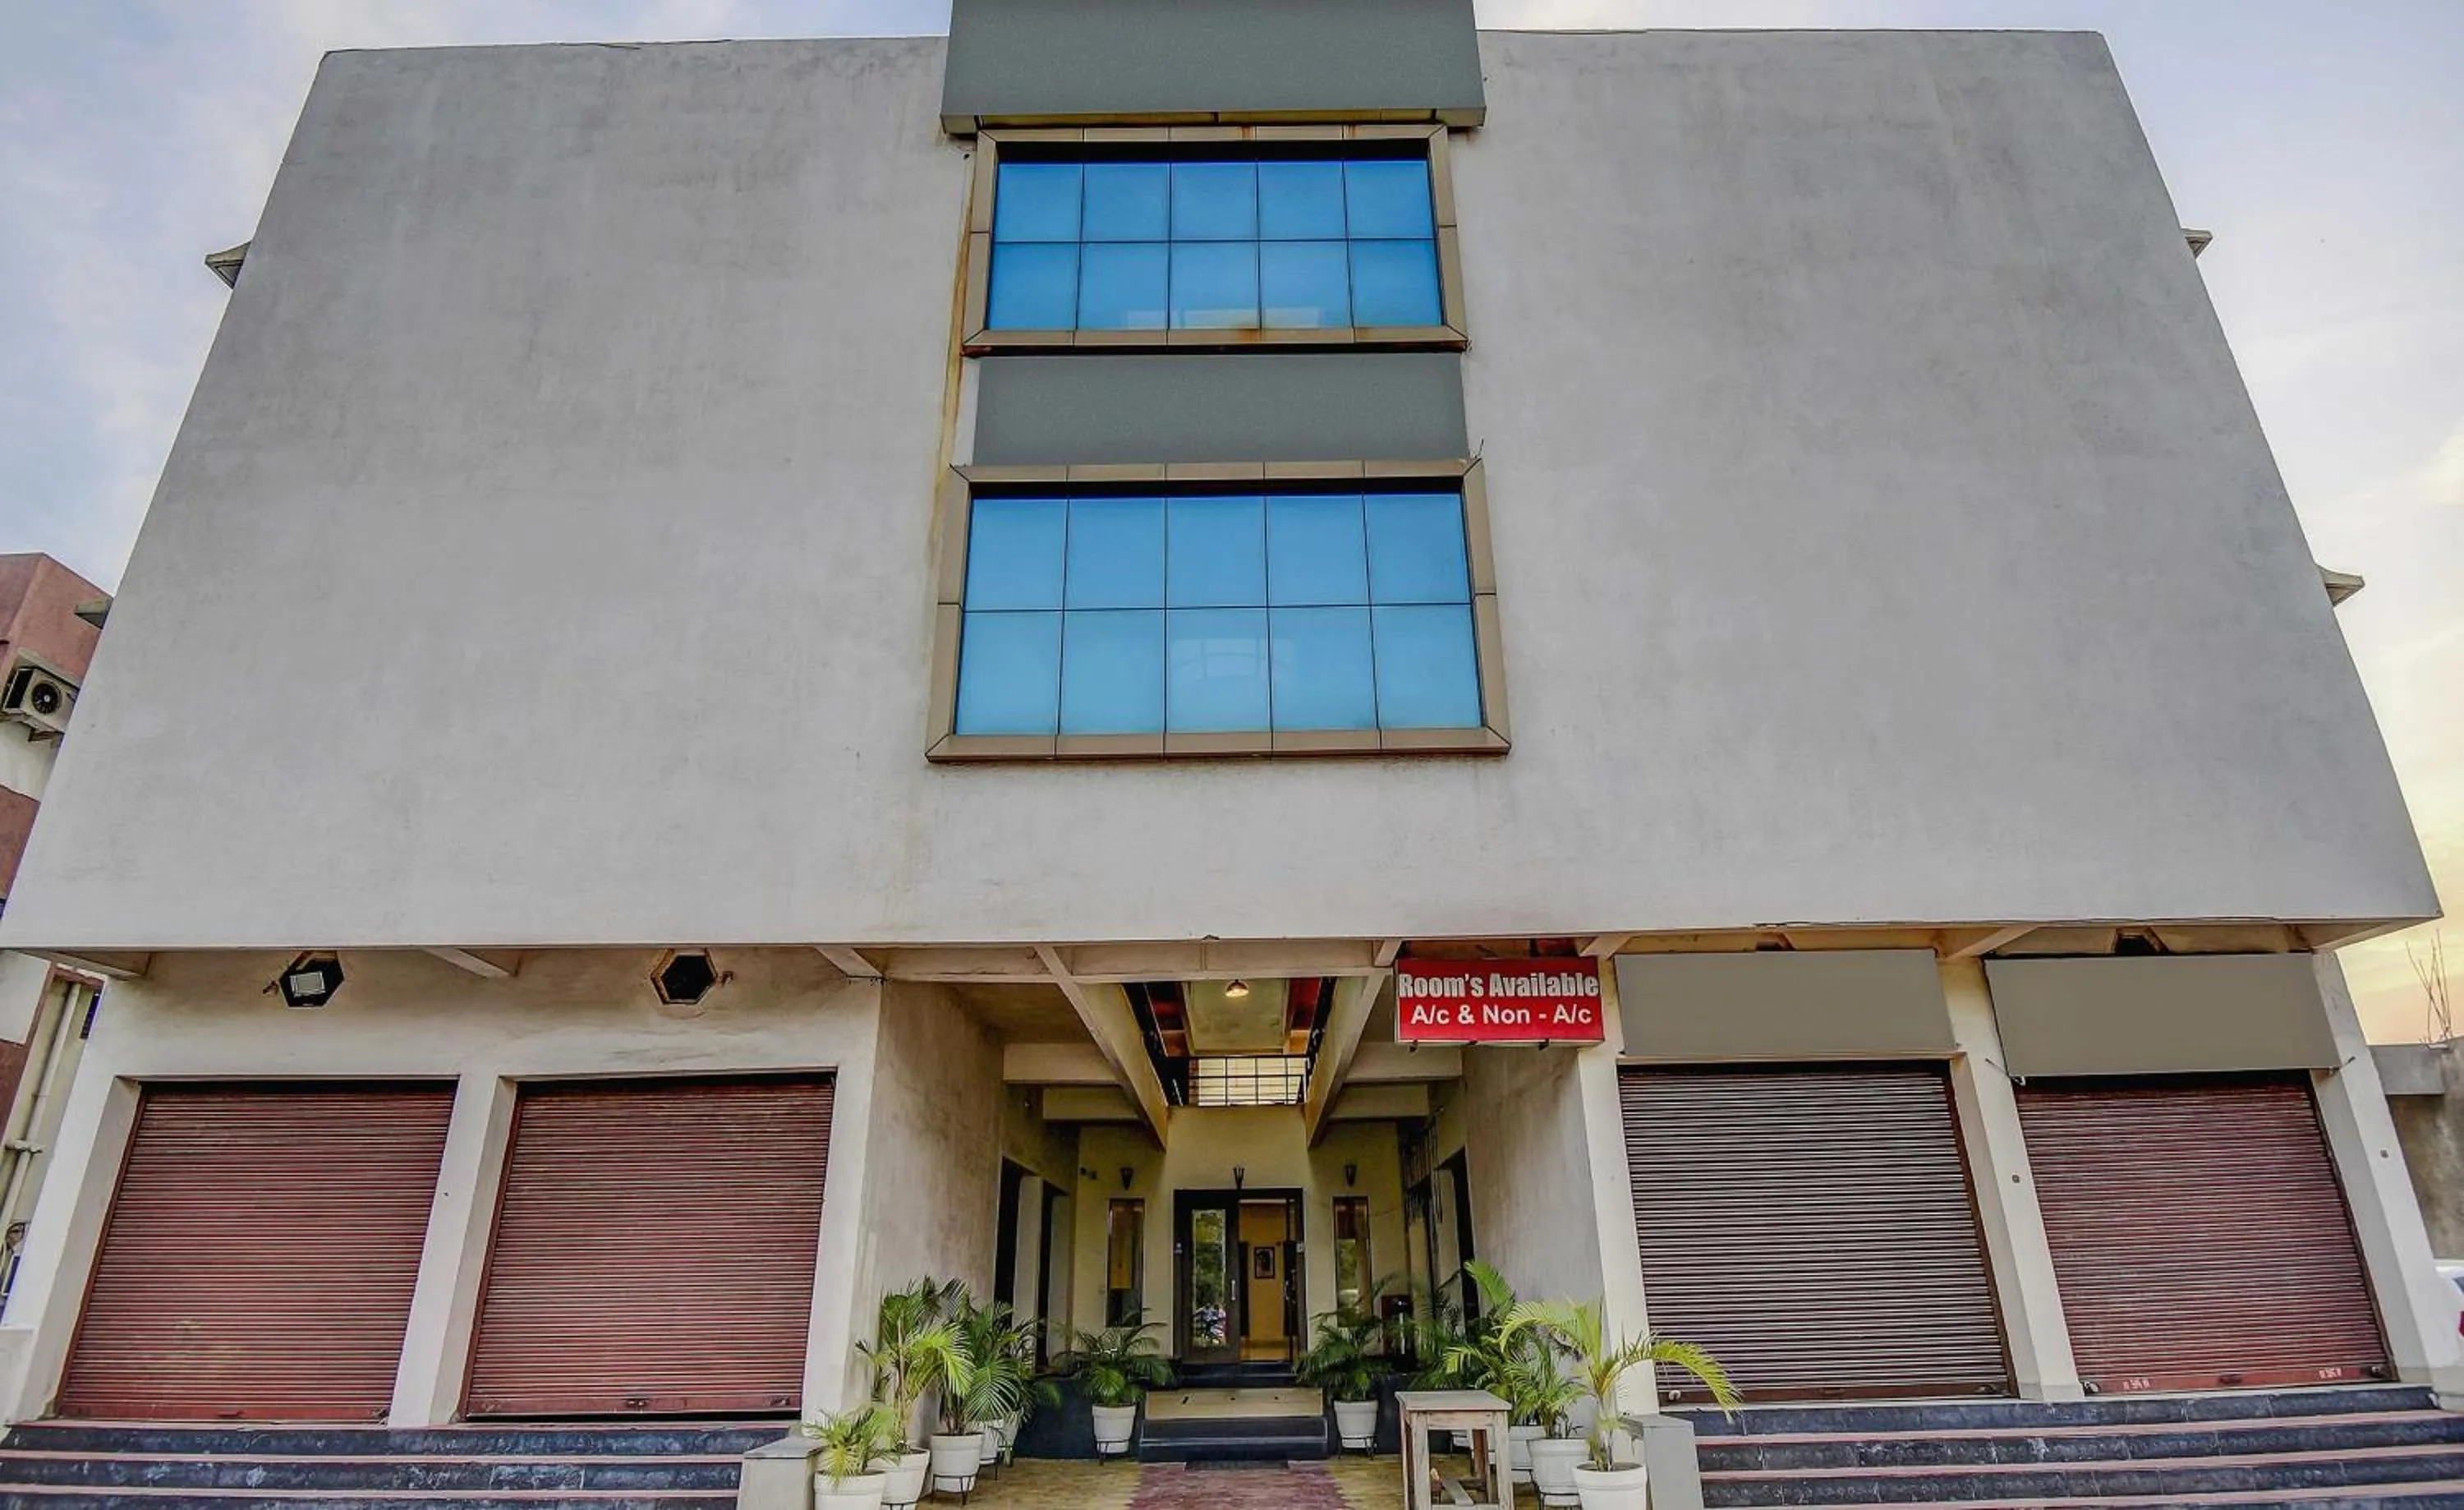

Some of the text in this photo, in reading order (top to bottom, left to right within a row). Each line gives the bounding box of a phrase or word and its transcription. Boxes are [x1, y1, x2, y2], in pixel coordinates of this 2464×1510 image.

[1399, 972, 1599, 997] Room's Available
[1410, 1004, 1450, 1024] A/c
[1457, 1004, 1475, 1024] &
[1483, 1004, 1530, 1024] Non
[1553, 1003, 1592, 1024] A/c
